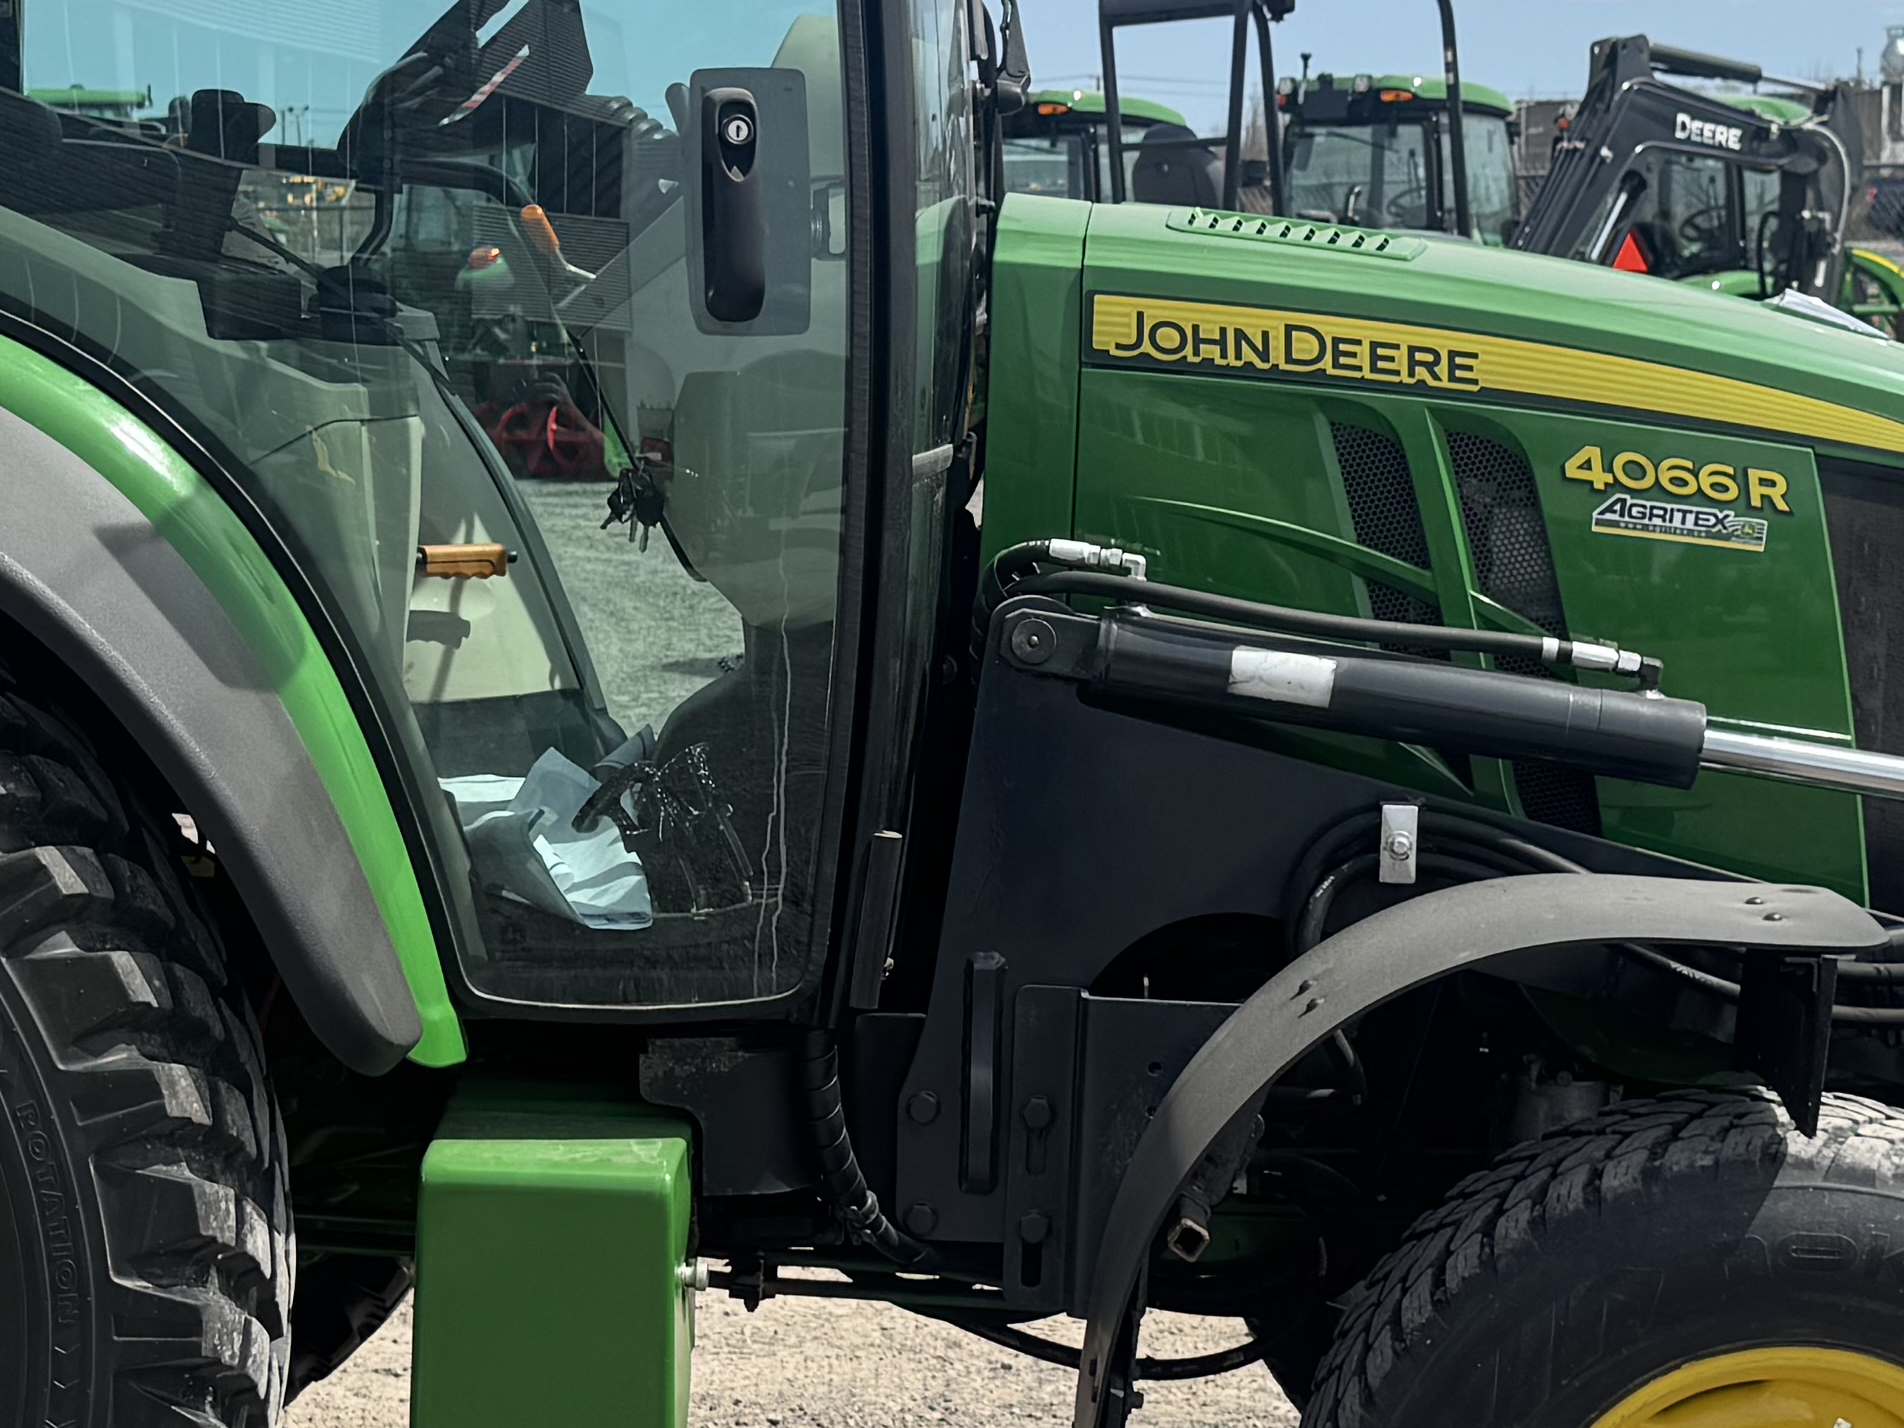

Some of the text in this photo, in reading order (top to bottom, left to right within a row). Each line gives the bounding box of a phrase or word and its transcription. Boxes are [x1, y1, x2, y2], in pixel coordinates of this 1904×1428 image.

[1675, 112, 1742, 150] DEERE
[1114, 310, 1479, 385] JOHN DEERE
[1597, 497, 1732, 531] AGRITEX
[13, 1100, 77, 1324] ROTATION
